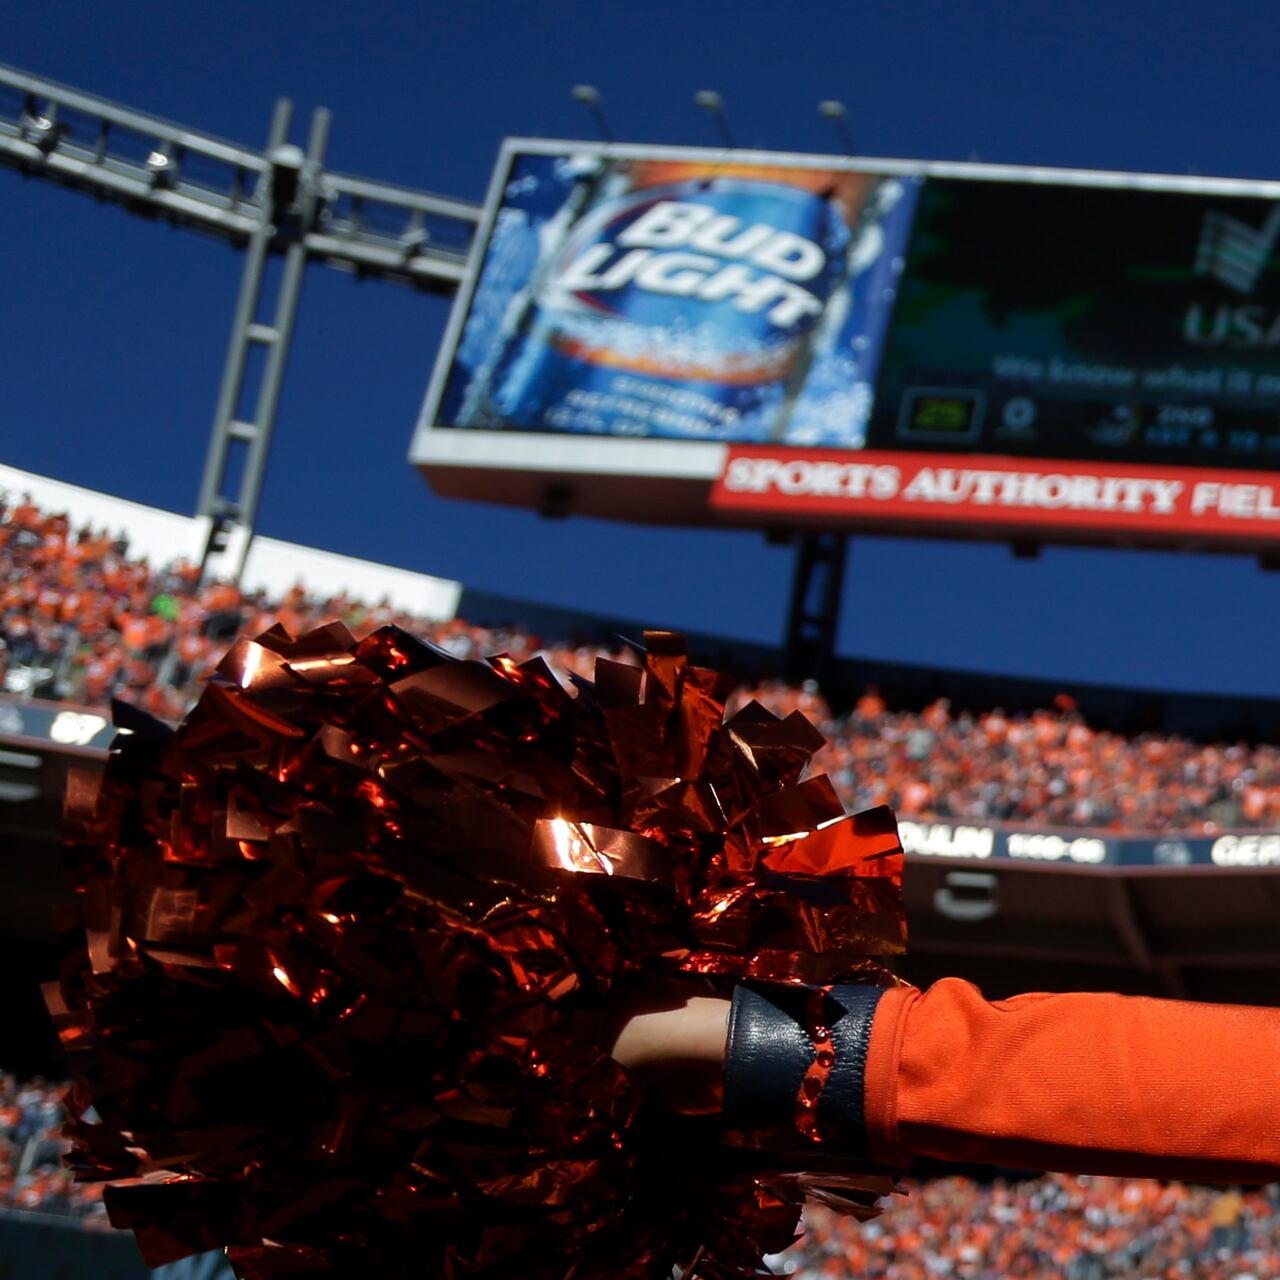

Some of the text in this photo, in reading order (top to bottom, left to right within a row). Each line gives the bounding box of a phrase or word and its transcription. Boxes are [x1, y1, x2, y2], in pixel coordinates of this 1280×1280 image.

[618, 200, 826, 283] BUD
[557, 242, 824, 328] LIGHT
[724, 455, 899, 499] SPORTS
[904, 467, 1182, 515] AUTHORITY
